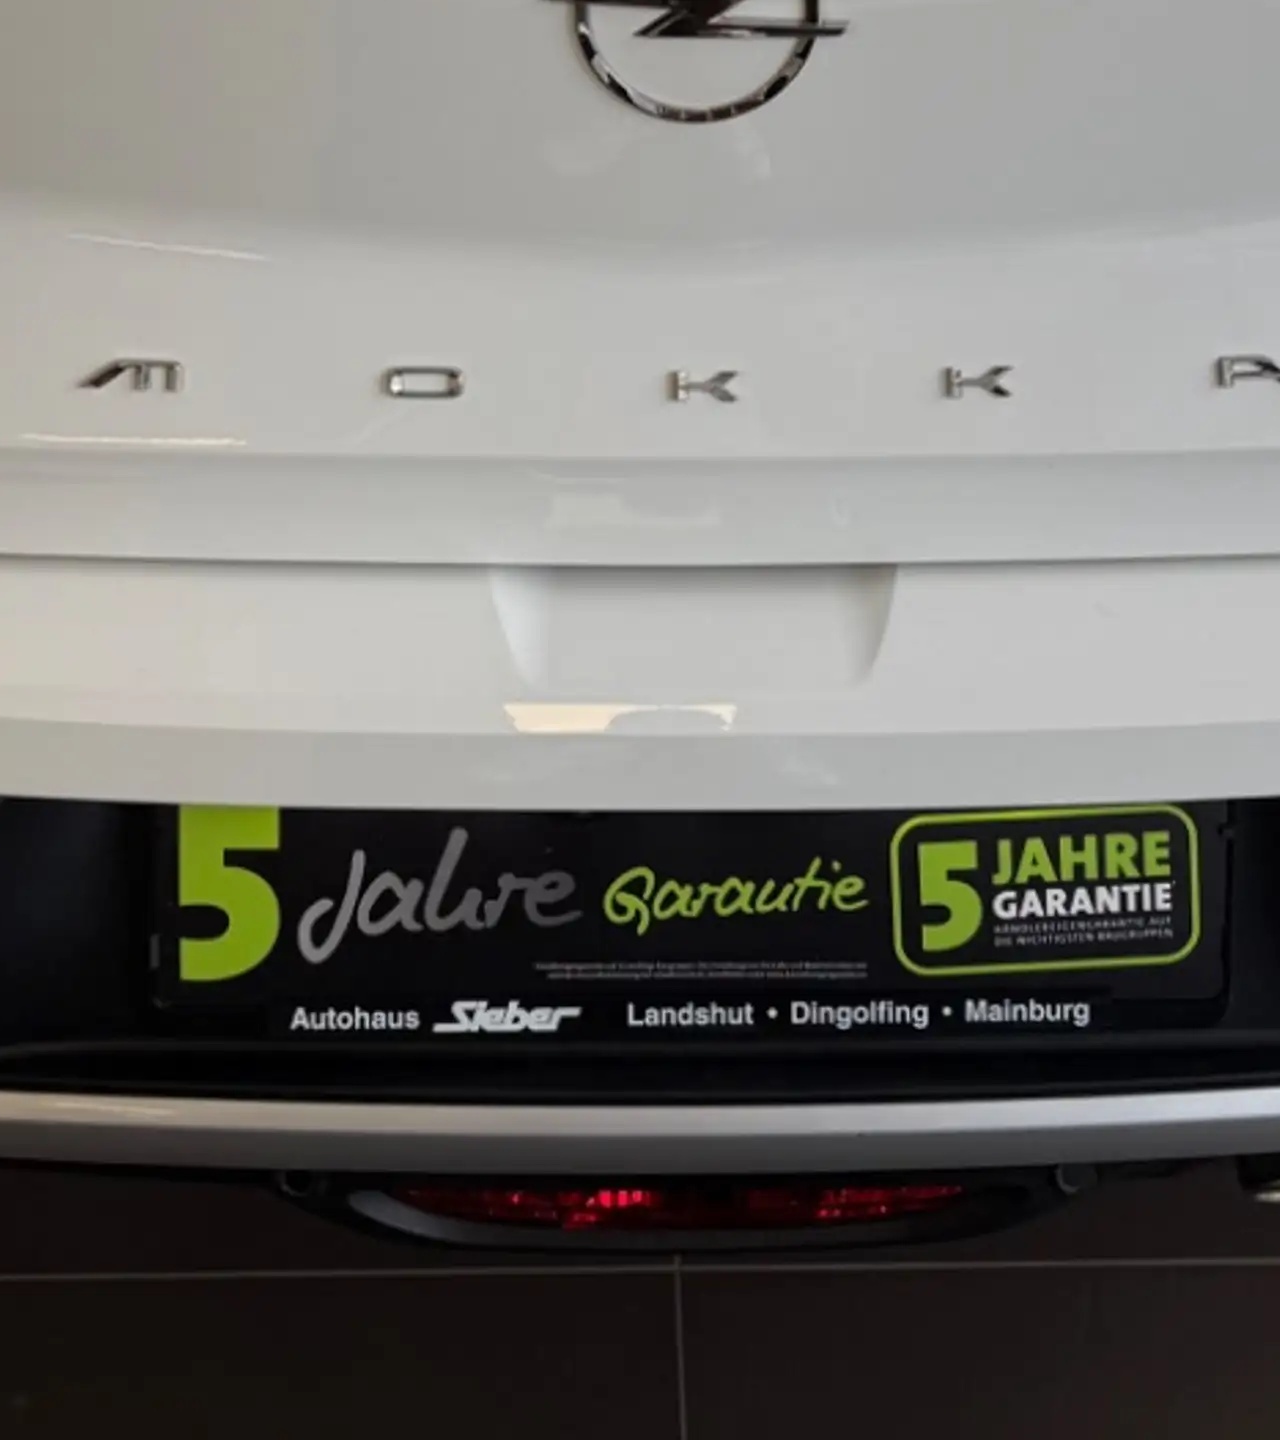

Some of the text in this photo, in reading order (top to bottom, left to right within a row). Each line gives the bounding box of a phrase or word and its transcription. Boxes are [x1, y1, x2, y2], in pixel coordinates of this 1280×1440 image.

[991, 830, 1172, 886] JAHRE
[179, 806, 869, 981] 5 Jahre Garantie
[918, 839, 983, 953] 5
[991, 883, 1174, 920] GARANTIE
[289, 999, 1091, 1034] Autohaus Sieber Landshut Dingolfing Mainburg
